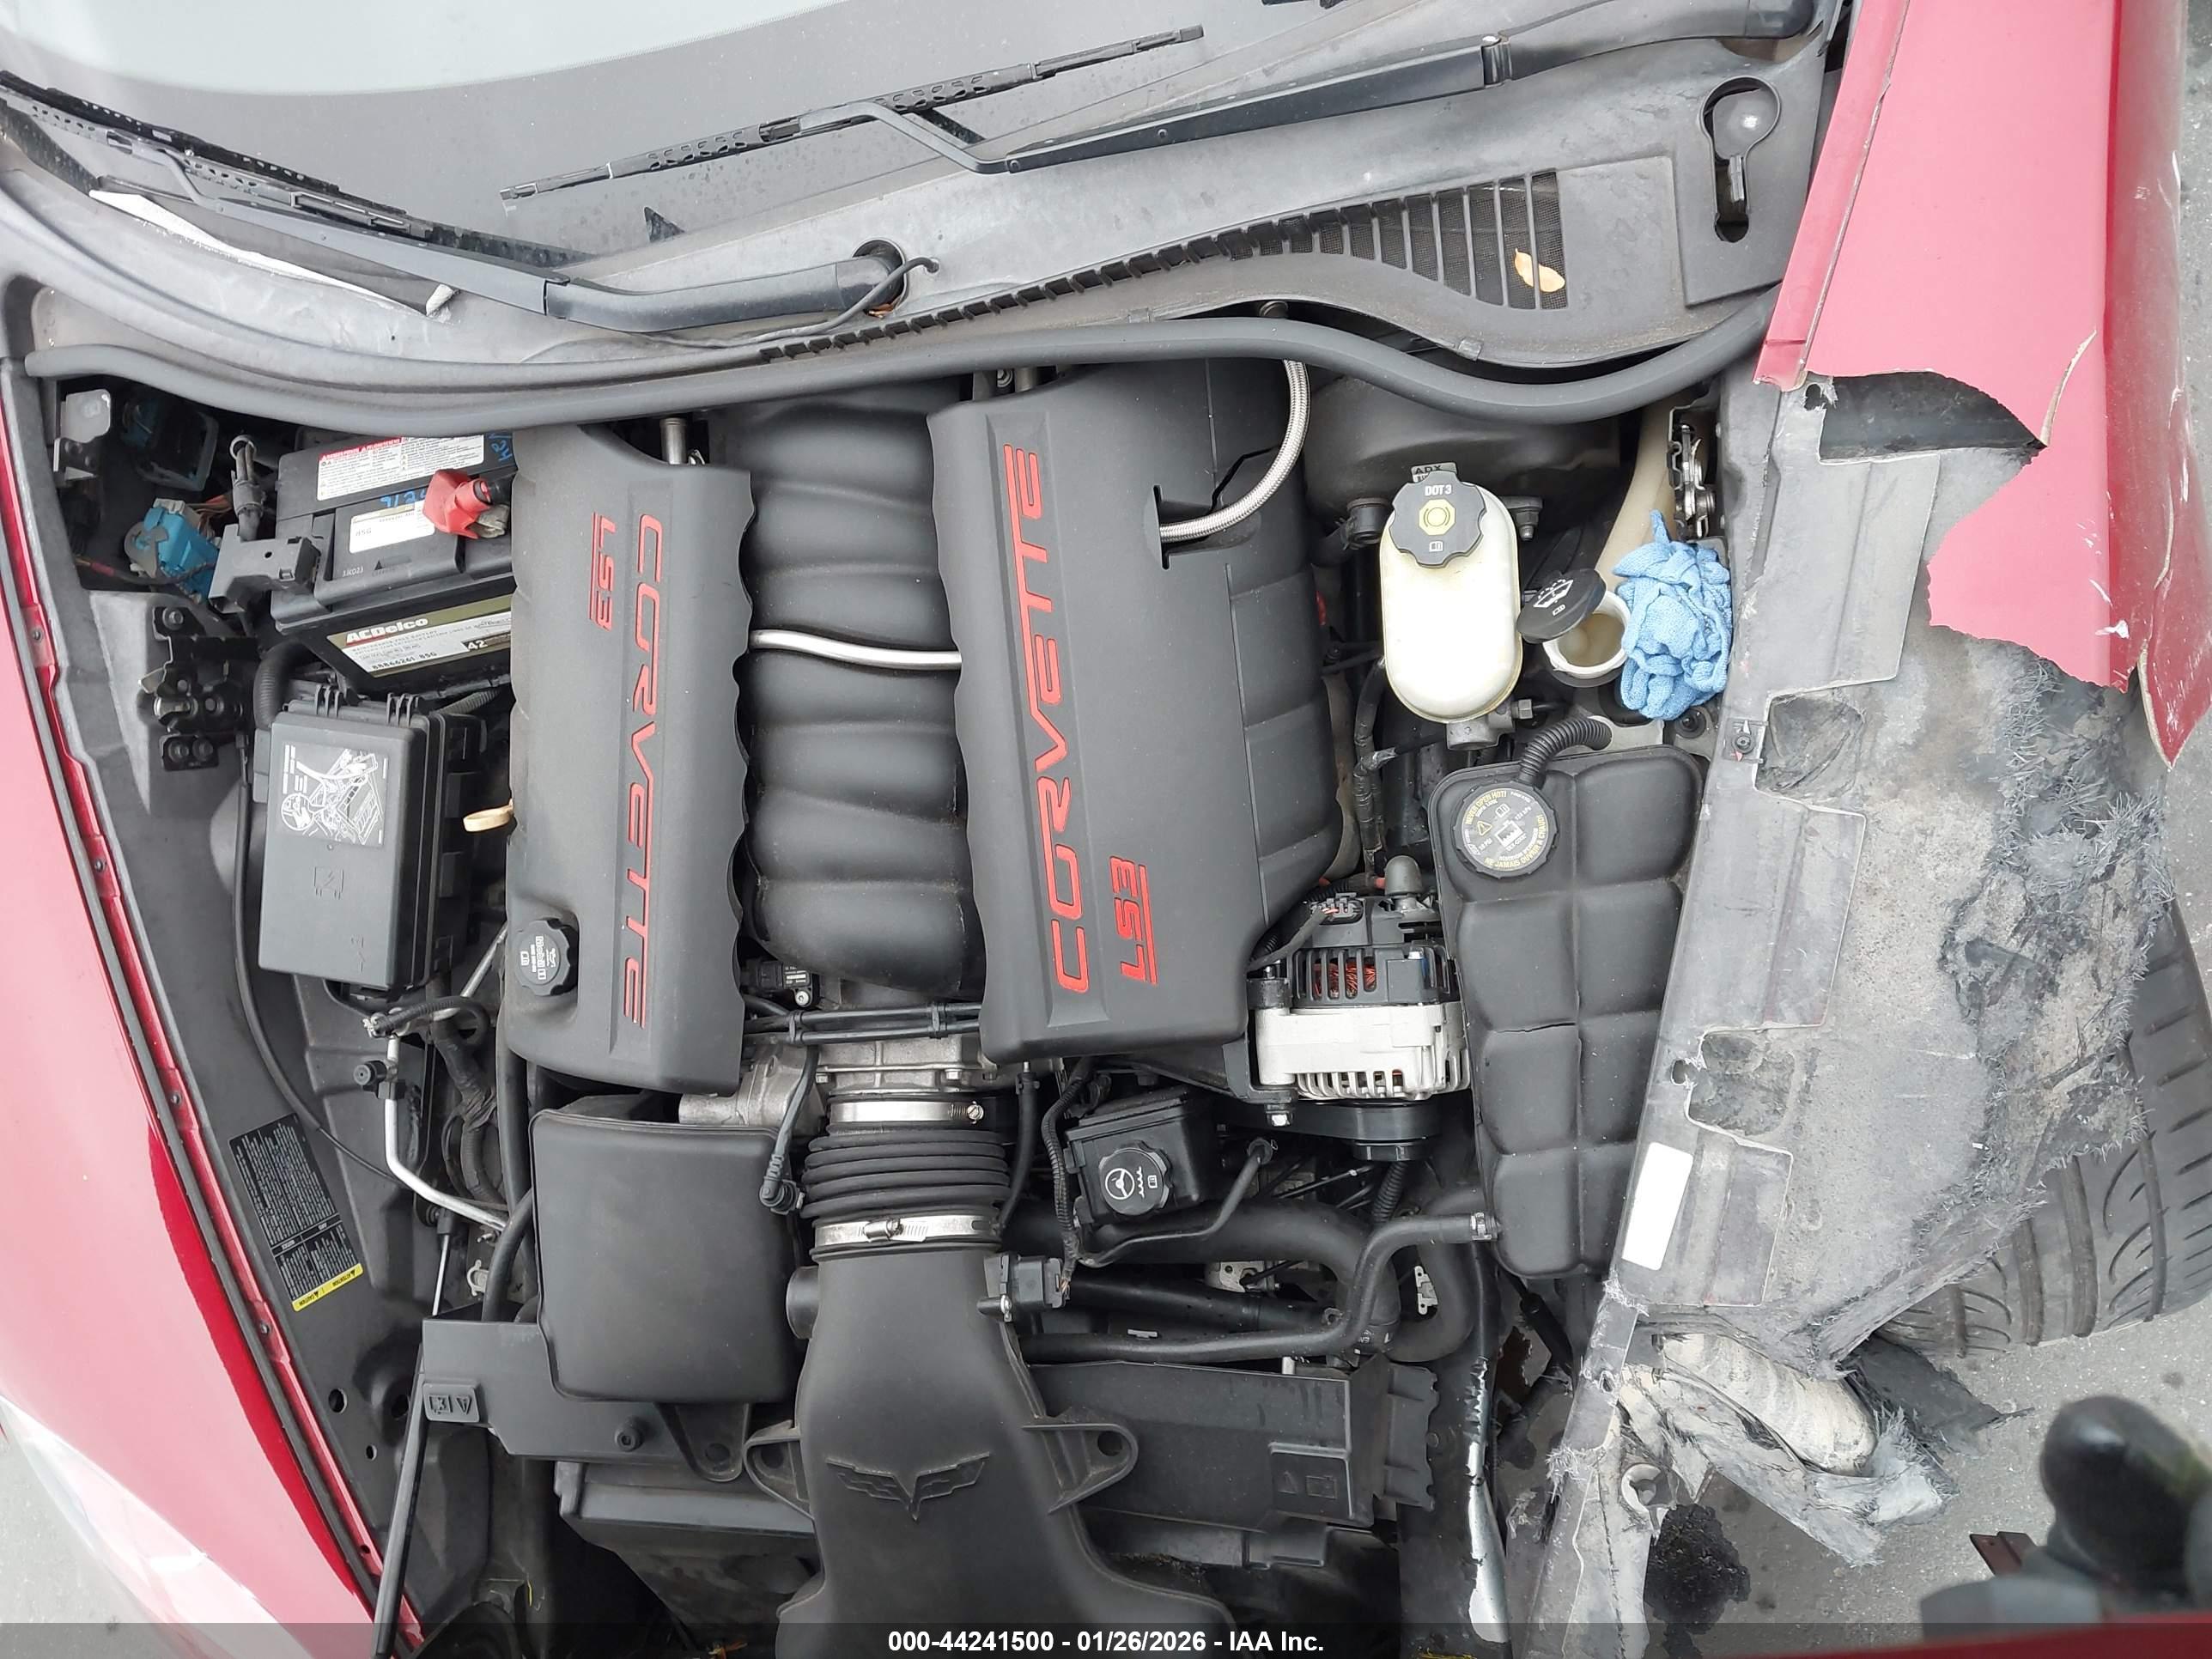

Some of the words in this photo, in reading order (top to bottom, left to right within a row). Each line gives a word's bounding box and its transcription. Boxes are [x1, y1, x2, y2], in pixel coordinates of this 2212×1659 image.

[1415, 465, 1441, 474] ADX
[1425, 485, 1444, 496] DOT
[1444, 484, 1452, 495] 3
[589, 513, 617, 631] LS3
[346, 617, 428, 644] ACDelco
[467, 640, 489, 650] A2
[1004, 443, 1089, 994] CORVETTE
[623, 514, 663, 1029] CORVETTE
[1494, 859, 1521, 868] JAMAIS
[1109, 855, 1156, 984] LS3
